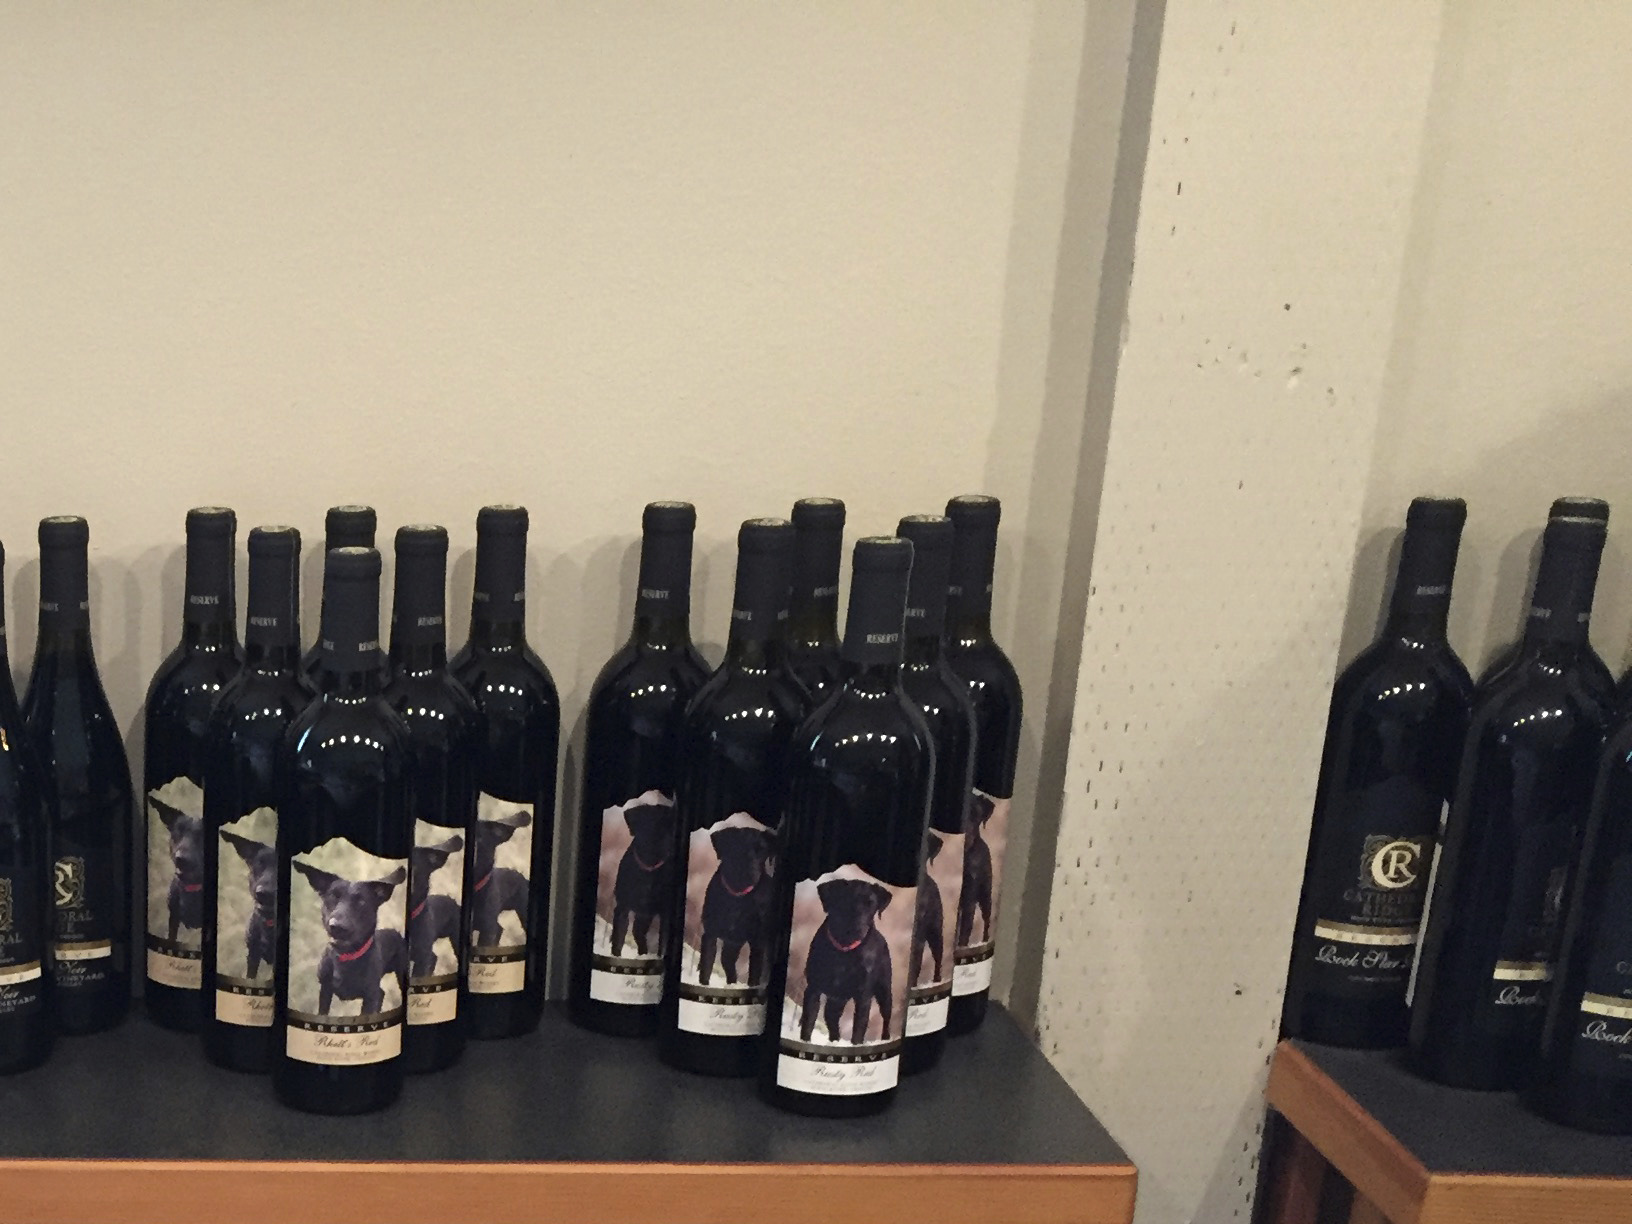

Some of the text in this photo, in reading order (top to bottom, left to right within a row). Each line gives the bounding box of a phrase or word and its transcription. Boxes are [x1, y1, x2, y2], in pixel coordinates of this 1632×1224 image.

[1371, 841, 1421, 889] CR
[304, 1021, 389, 1034] RESERVE
[798, 1051, 888, 1064] RESERVE
